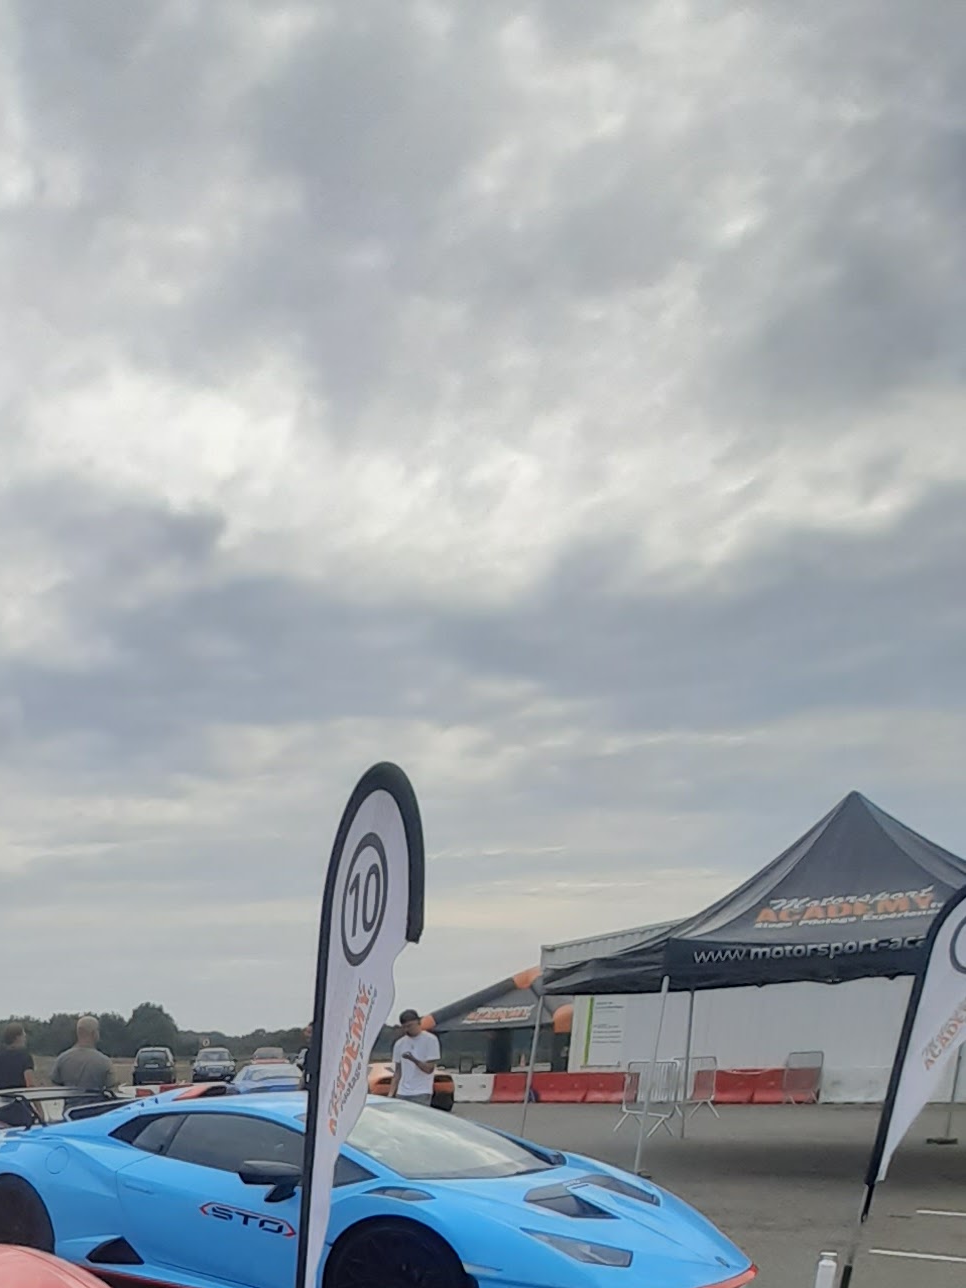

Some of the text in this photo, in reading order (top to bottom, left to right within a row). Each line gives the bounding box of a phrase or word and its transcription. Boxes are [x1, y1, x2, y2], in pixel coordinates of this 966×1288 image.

[349, 863, 380, 938] 10
[756, 893, 933, 923] ACADEMY
[770, 884, 934, 911] Motorsport
[211, 1206, 284, 1234] STO
